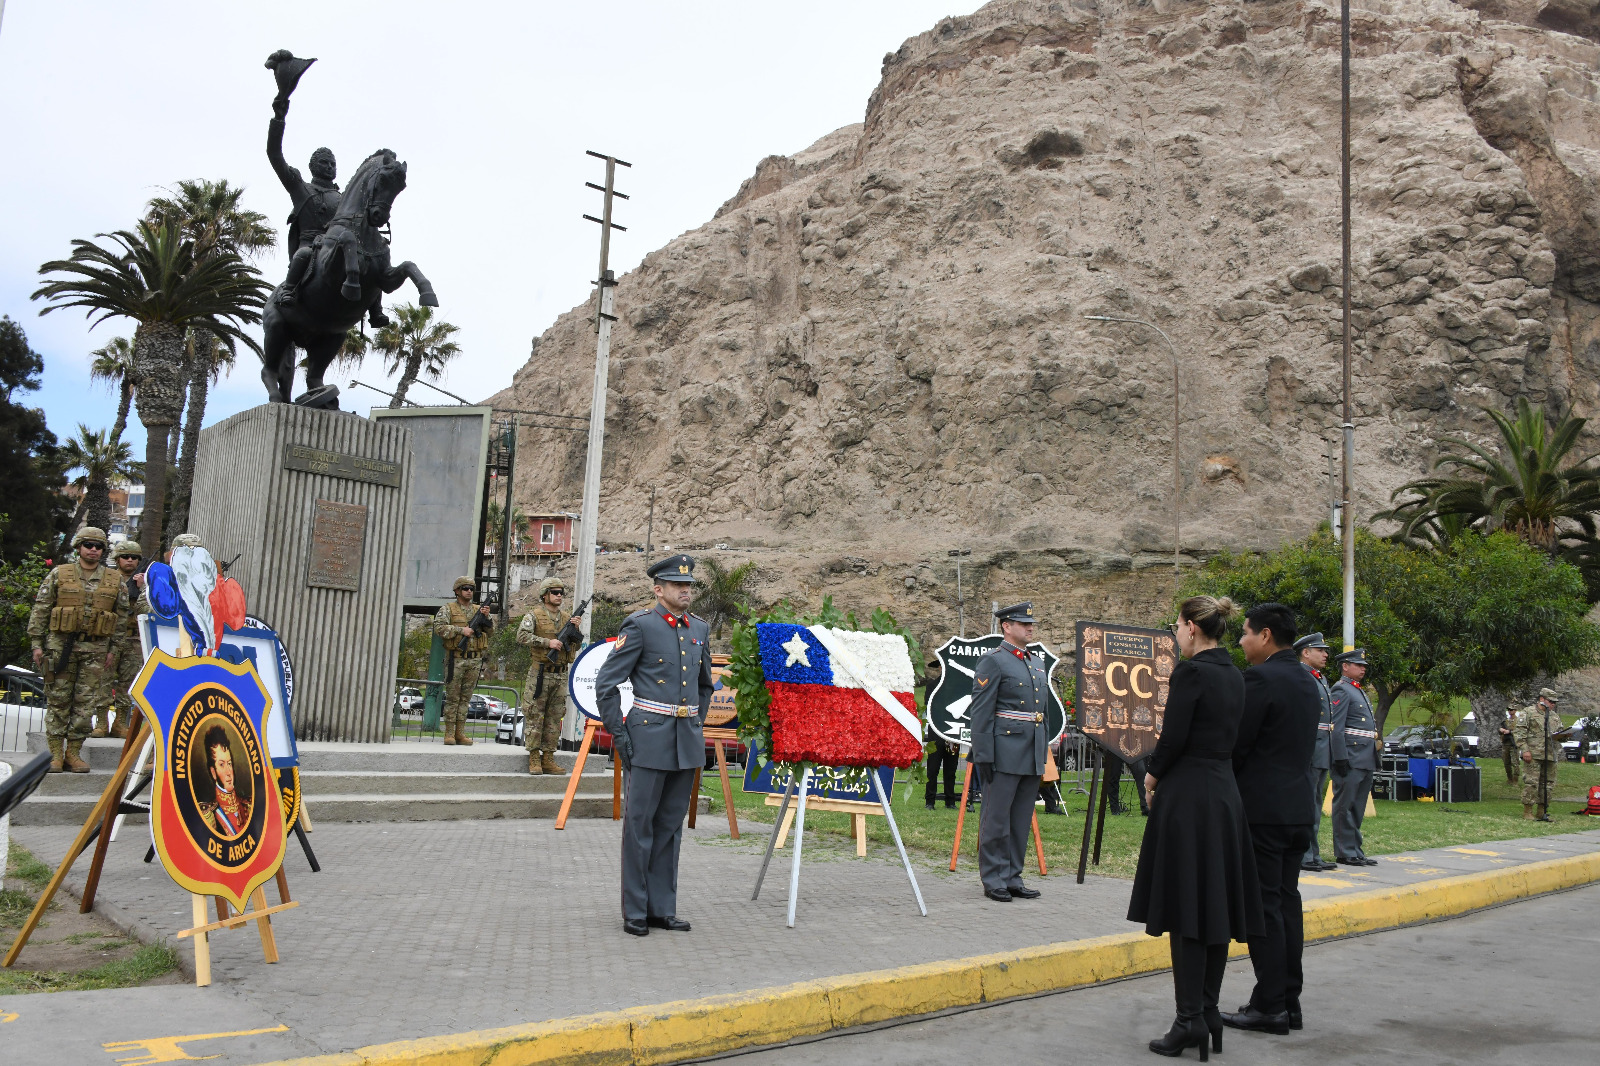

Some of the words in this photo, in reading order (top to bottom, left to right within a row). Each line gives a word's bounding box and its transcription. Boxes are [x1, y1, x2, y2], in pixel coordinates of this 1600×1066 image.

[1108, 641, 1149, 650] CONSULAR
[1113, 635, 1144, 643] CUERPO
[1105, 661, 1153, 699] CC
[175, 700, 204, 779] INSTITUTO
[207, 695, 261, 775] O'HIGGINIANO
[207, 836, 223, 860] DE
[228, 833, 256, 862] ARICA
